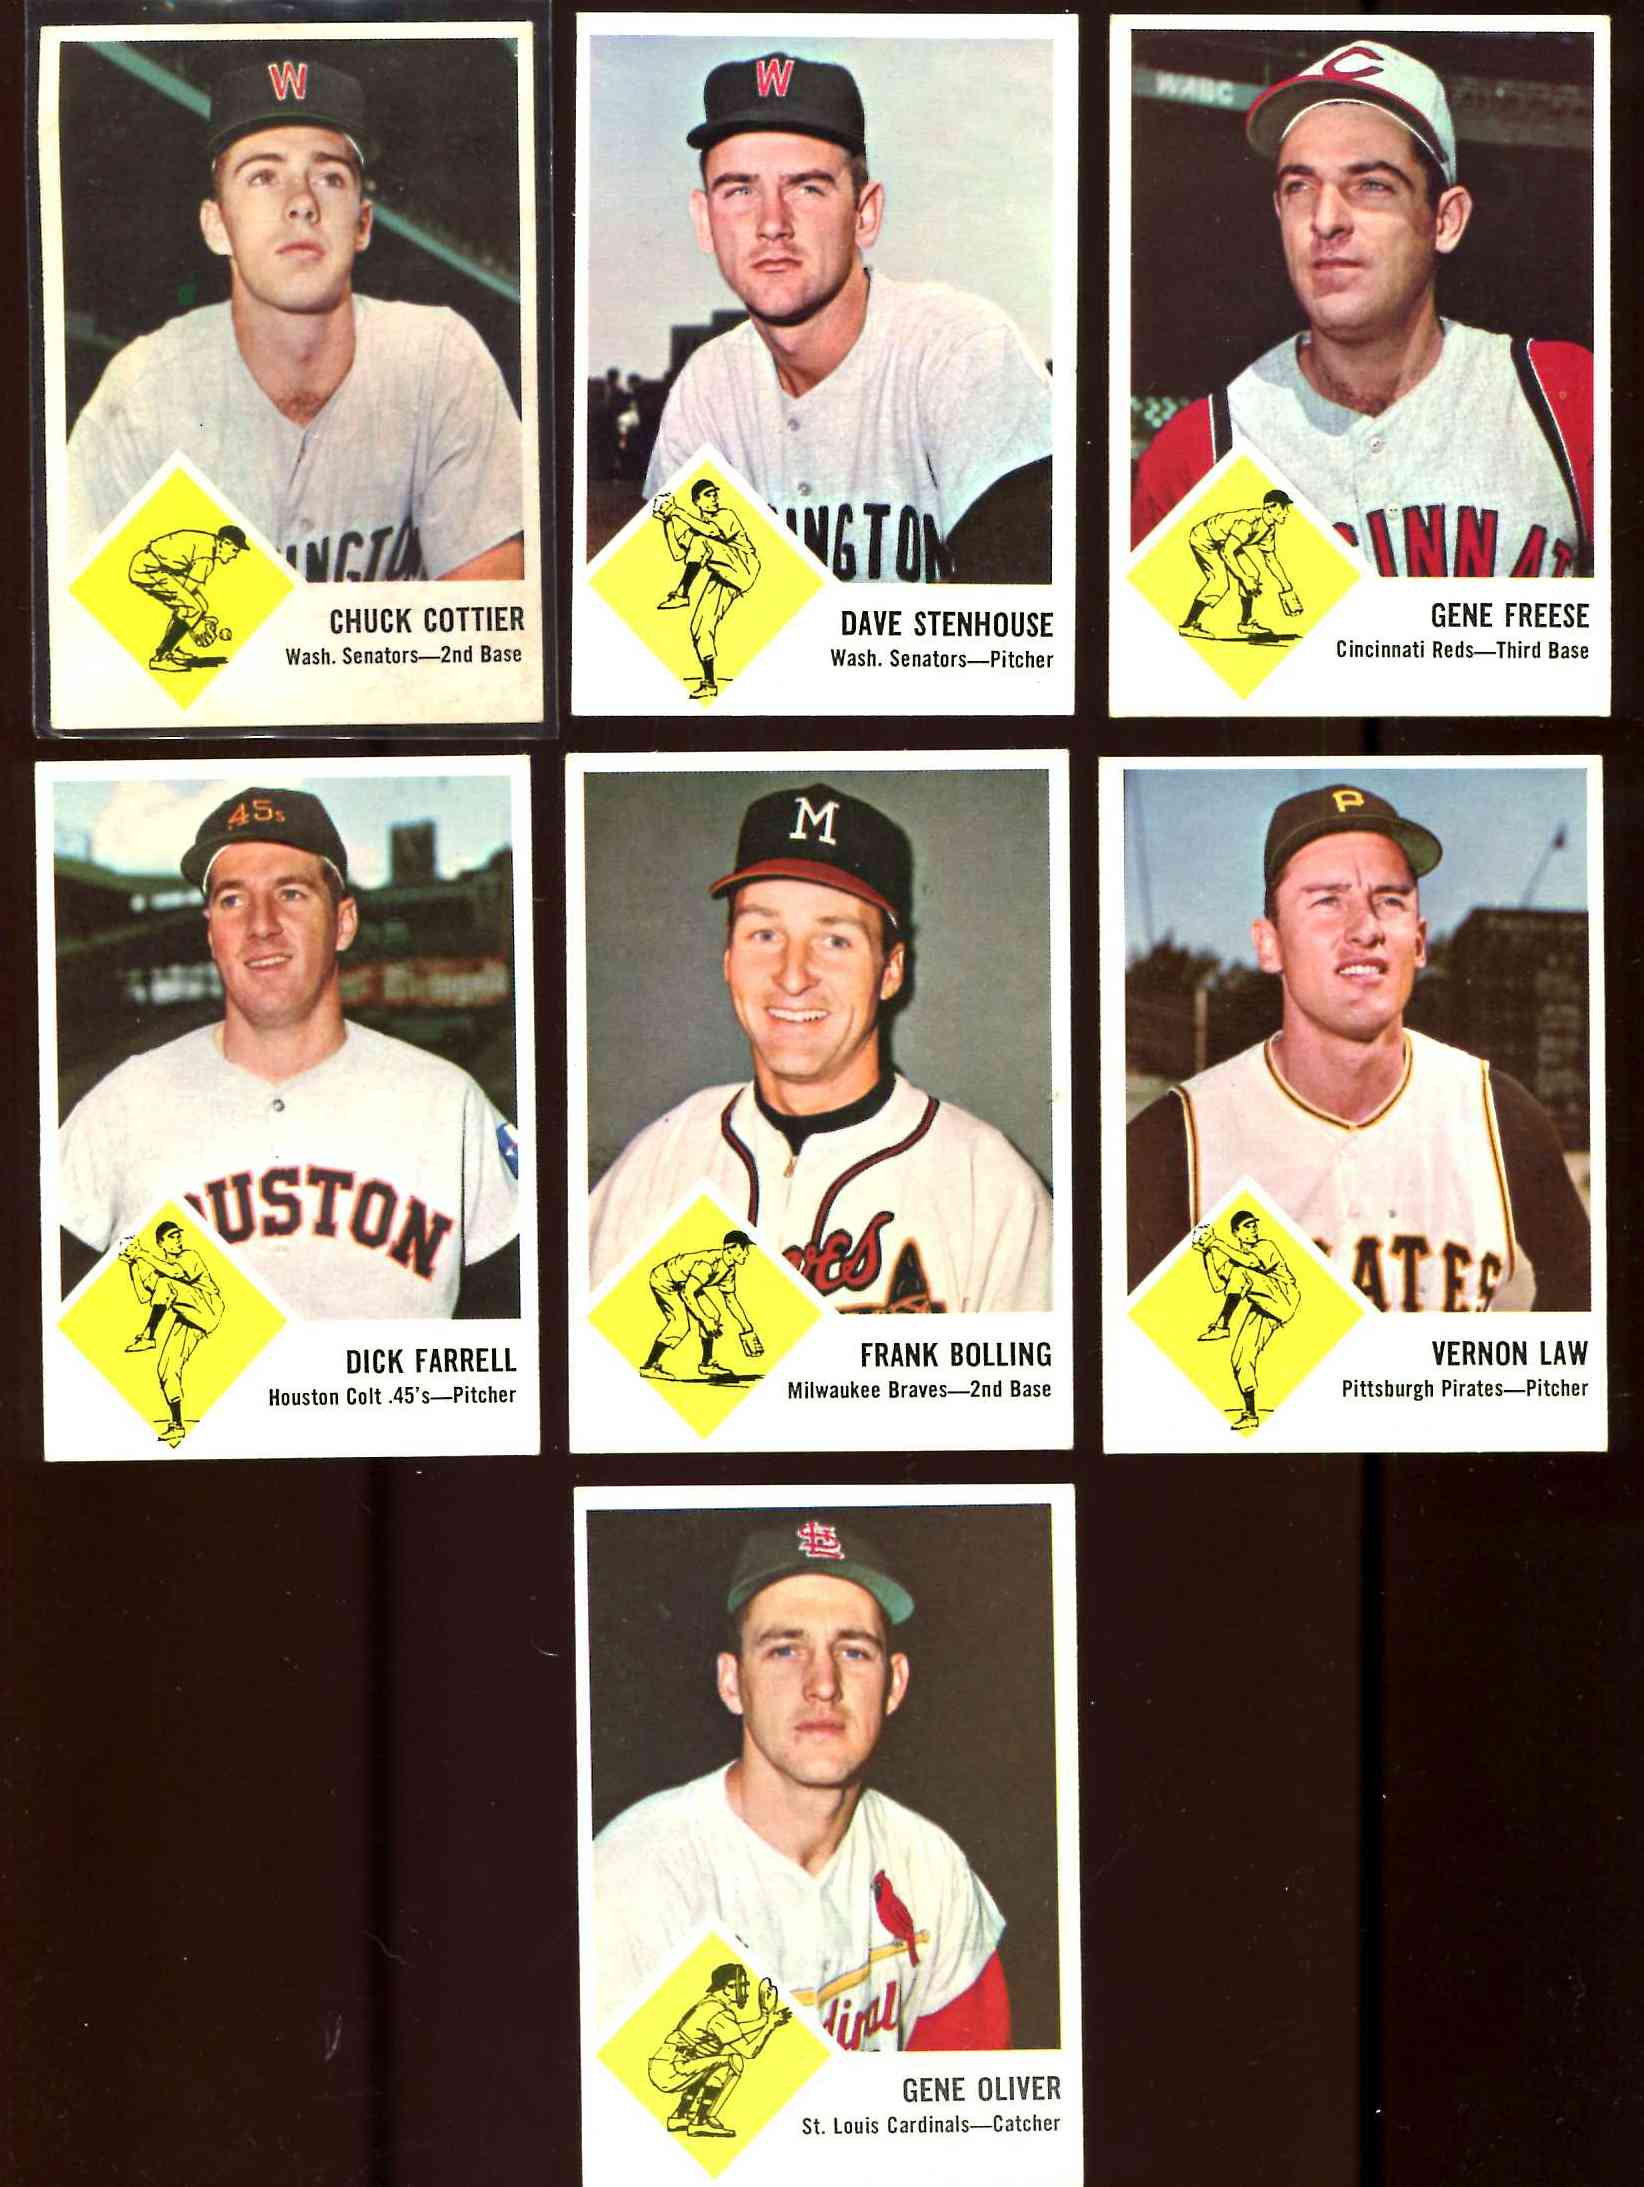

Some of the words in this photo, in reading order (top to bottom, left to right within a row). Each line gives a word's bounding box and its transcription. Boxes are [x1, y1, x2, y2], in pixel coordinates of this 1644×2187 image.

[1322, 46, 1384, 81] C
[268, 61, 308, 101] W
[756, 58, 795, 97] W
[330, 608, 412, 635] CHUCK
[424, 606, 525, 633] COTTIER
[841, 610, 902, 637] DAVE
[913, 610, 1054, 638] STENHOUSE
[1431, 602, 1493, 628] GENE
[1505, 602, 1590, 629] FREESE
[285, 647, 336, 666] Wash.
[480, 644, 522, 663] Base
[830, 648, 883, 667] Wash.
[1336, 639, 1425, 659] Cincinnati
[1548, 641, 1589, 660] Base
[1332, 790, 1365, 813] P
[789, 797, 840, 846] M
[183, 1163, 454, 1282] USTON
[1312, 1234, 1503, 1312] ATES
[346, 1348, 404, 1375] DICK
[415, 1347, 517, 1373] FARRELL
[861, 1342, 939, 1368] FRANK
[950, 1341, 1052, 1368] BOLLING
[1431, 1340, 1528, 1367] VERNON
[1540, 1340, 1589, 1366] LAW
[269, 1388, 339, 1407] Houston
[346, 1387, 382, 1406] Colt
[788, 1380, 881, 1400] Milwaukee
[1010, 1379, 1052, 1398] Base
[1342, 1379, 1434, 1402] Pittsburgh
[903, 2076, 966, 2103] GENE
[978, 2075, 1061, 2102] OLIVER
[802, 2117, 826, 2135] St.
[833, 2116, 879, 2135] Louis
